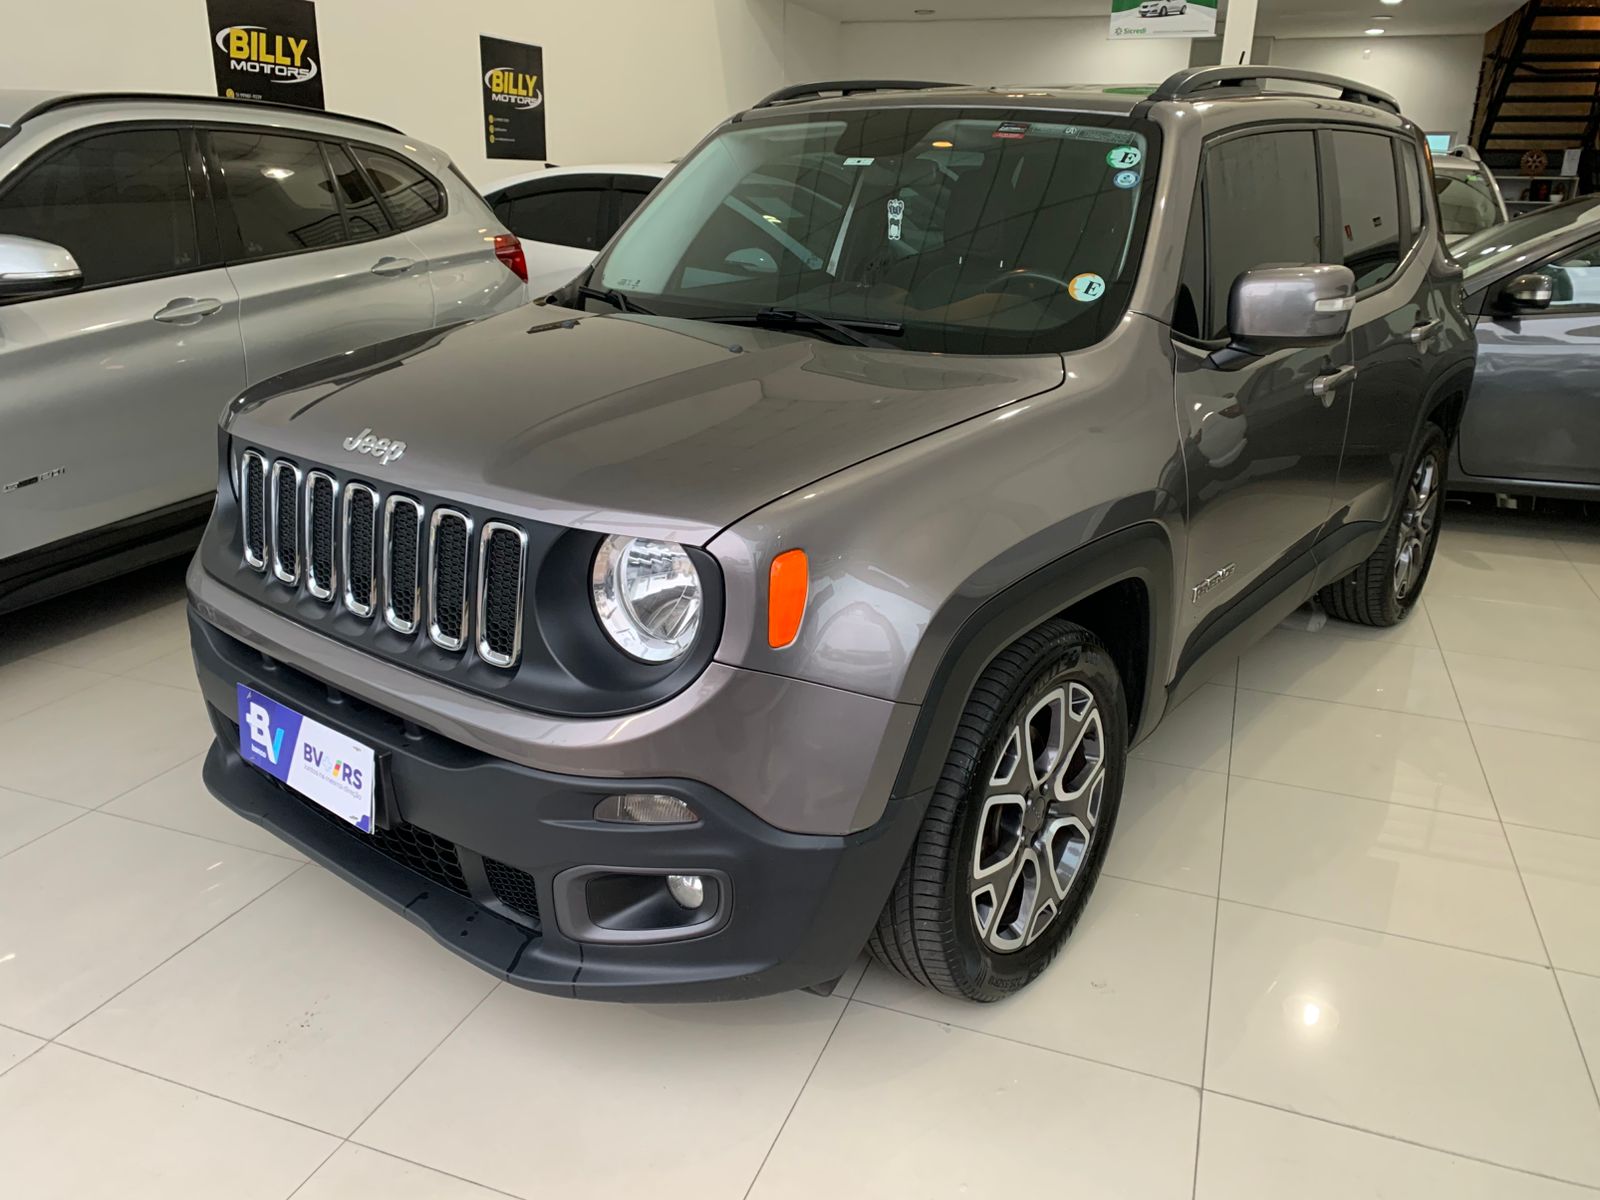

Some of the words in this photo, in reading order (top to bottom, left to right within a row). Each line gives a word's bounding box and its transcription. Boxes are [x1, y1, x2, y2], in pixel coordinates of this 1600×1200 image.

[229, 28, 308, 67] BILLY
[230, 60, 311, 80] MOTORS
[492, 69, 538, 97] BILLY
[491, 93, 538, 107] MOTORS
[1119, 151, 1138, 164] E
[1082, 280, 1102, 297] E
[342, 428, 407, 465] Jeep
